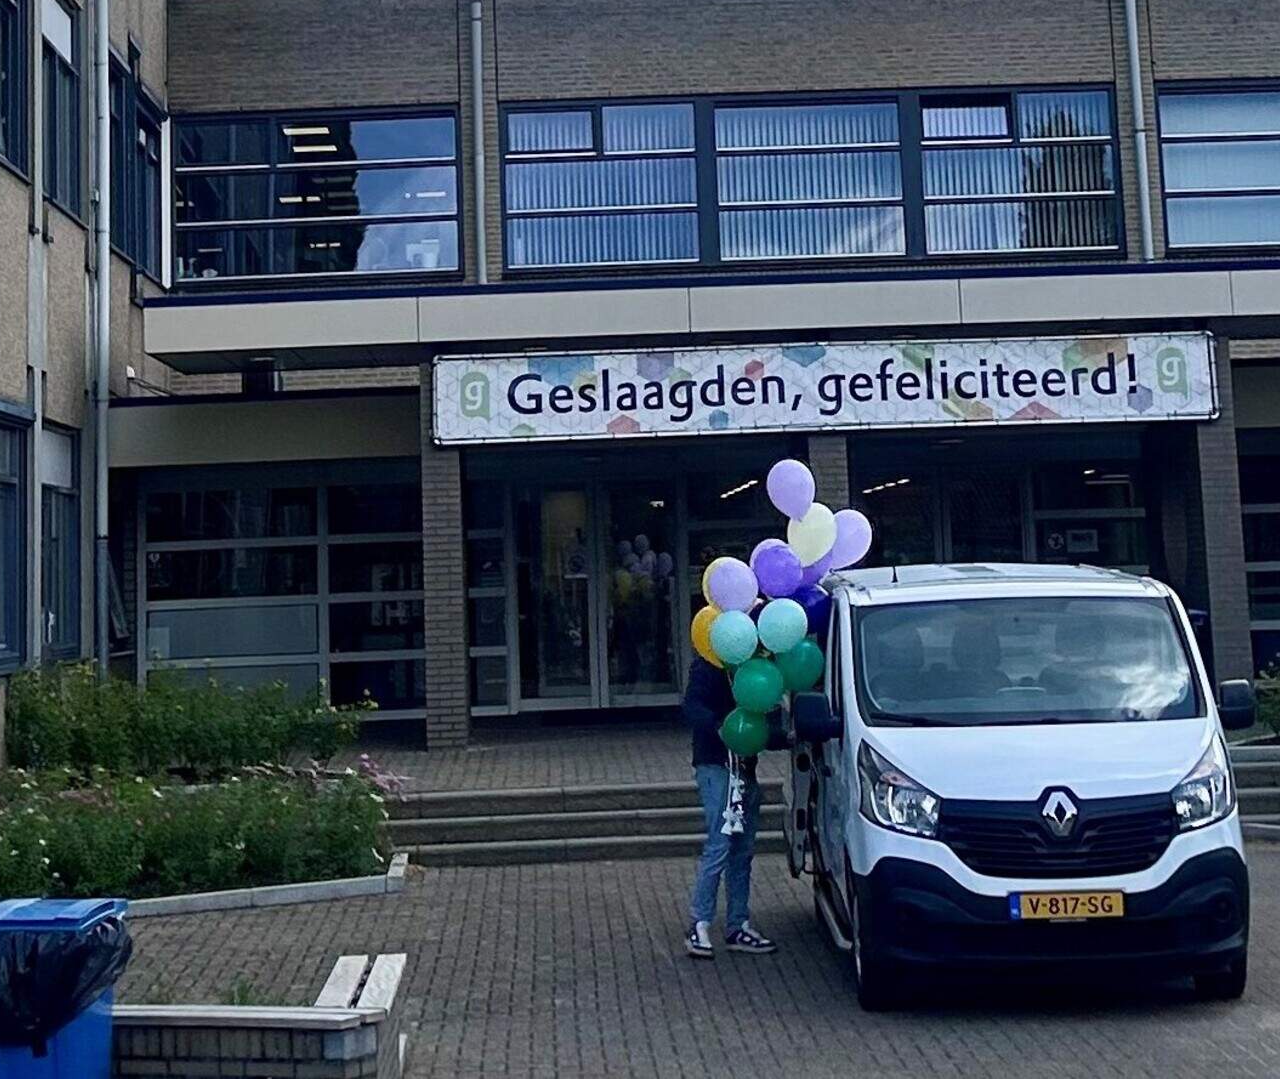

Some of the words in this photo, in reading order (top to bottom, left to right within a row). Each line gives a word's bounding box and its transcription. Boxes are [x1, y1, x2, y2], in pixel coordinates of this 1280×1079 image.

[1161, 354, 1182, 387] g
[463, 378, 486, 410] g
[507, 364, 802, 422] Geslaagden,
[818, 352, 1137, 416] gefeliciteerd!
[1028, 895, 1113, 915] V-817-SG
